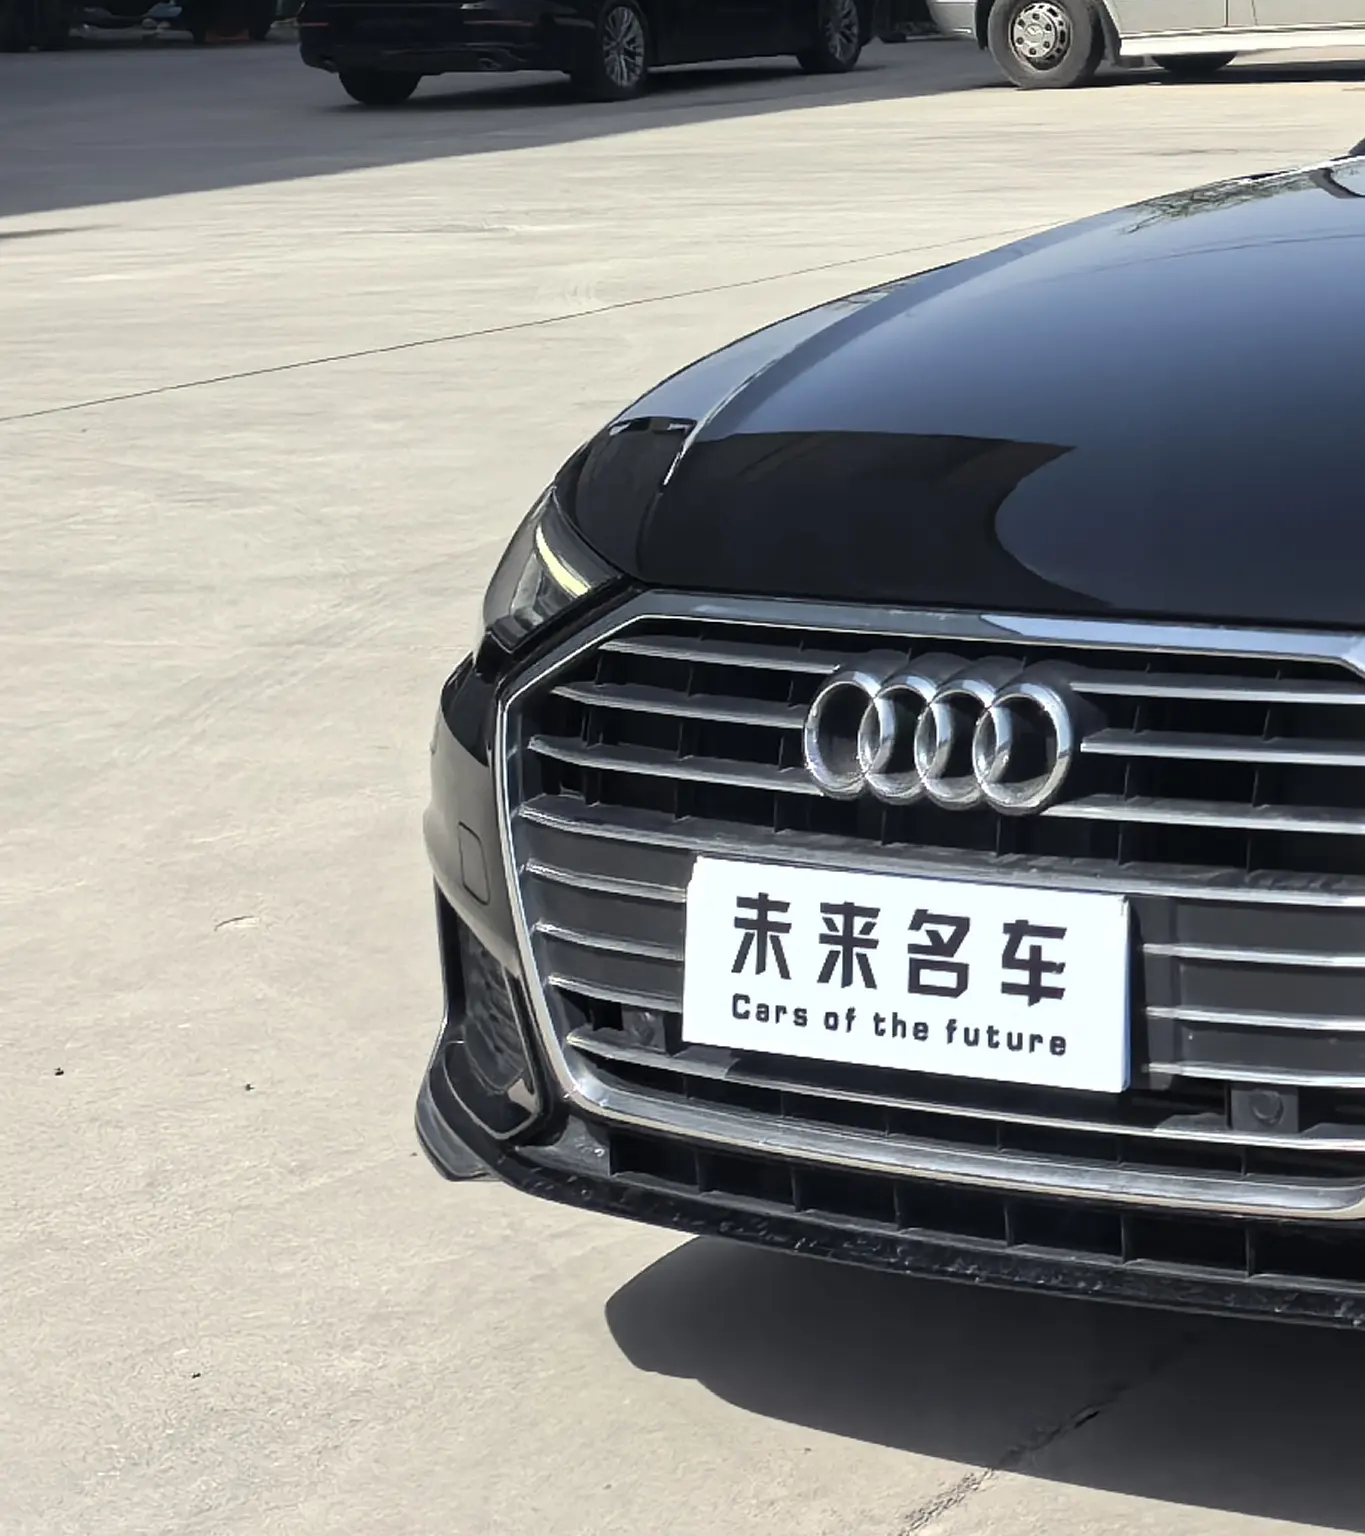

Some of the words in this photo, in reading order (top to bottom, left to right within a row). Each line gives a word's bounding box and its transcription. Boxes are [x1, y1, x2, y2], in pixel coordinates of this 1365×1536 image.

[731, 892, 1067, 1006] 未来名车
[732, 992, 808, 1028] Cars
[823, 1006, 857, 1033] of
[872, 1011, 929, 1042] the
[945, 1018, 1067, 1056] future
